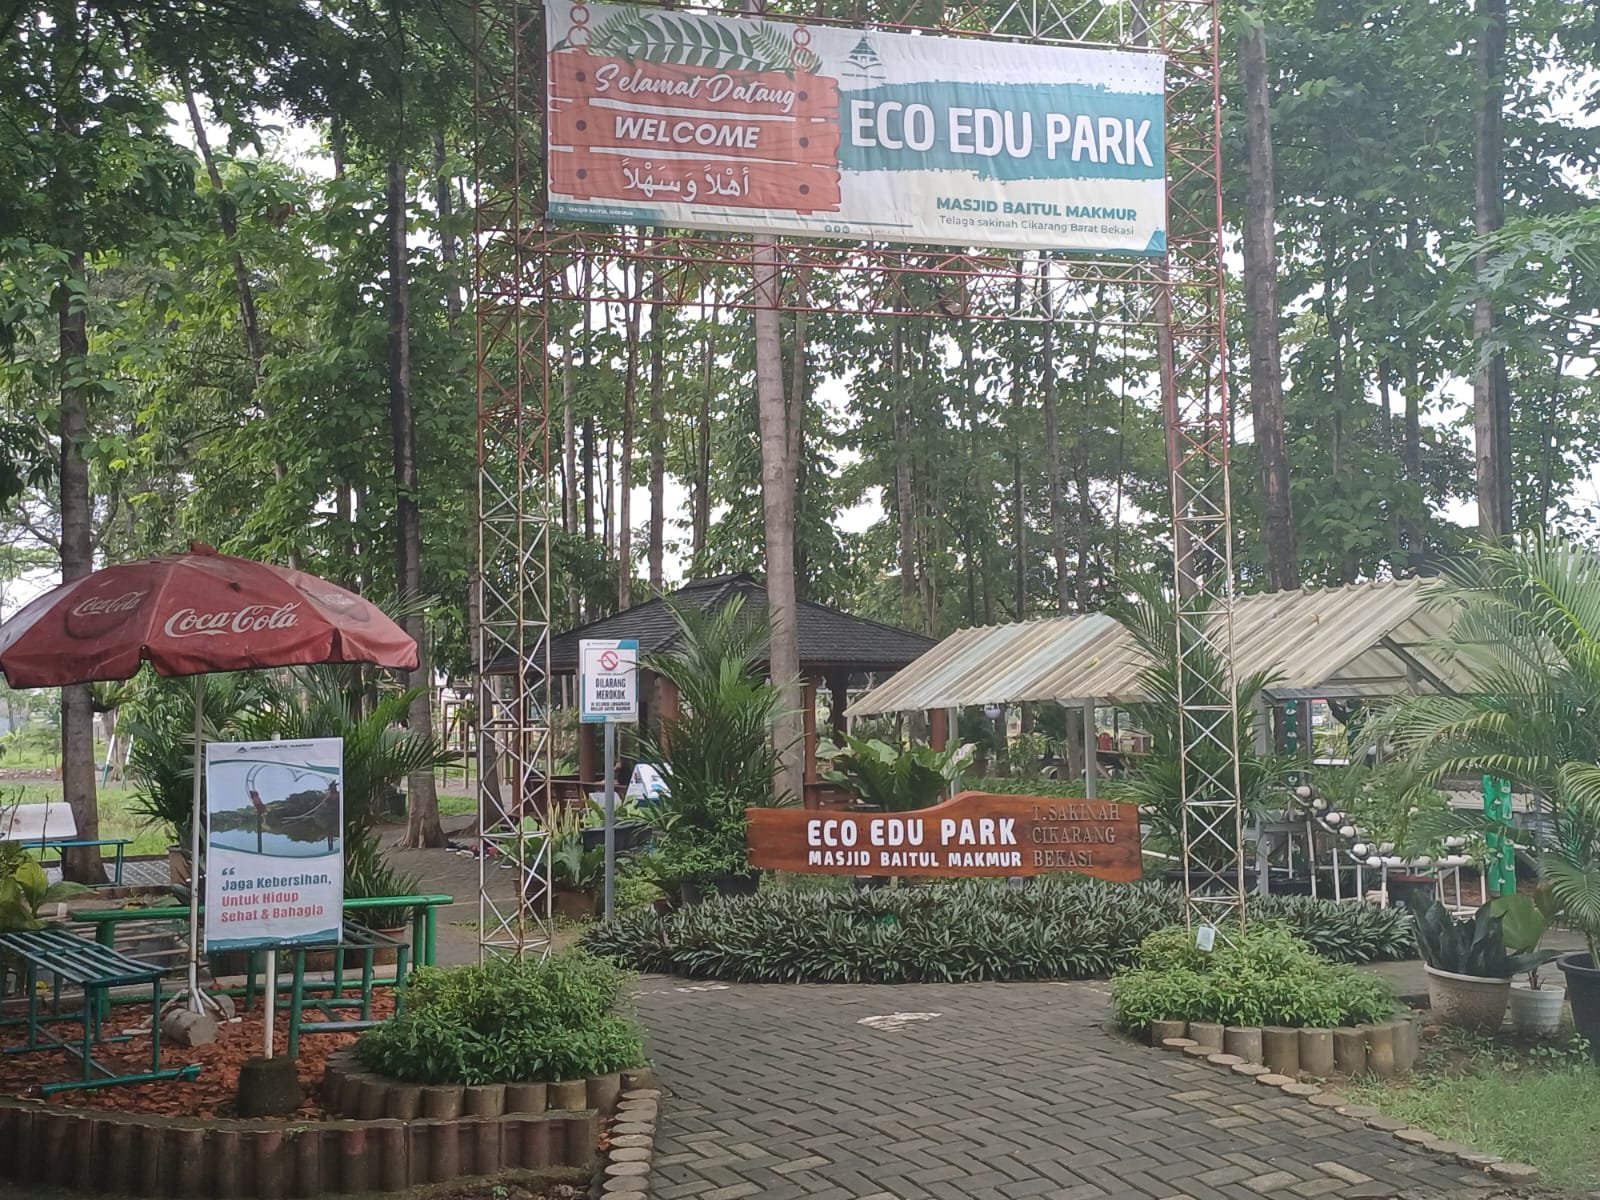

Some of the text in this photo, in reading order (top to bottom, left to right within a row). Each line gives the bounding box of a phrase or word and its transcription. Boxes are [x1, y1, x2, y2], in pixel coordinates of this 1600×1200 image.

[595, 63, 796, 113] Selamat Datang
[615, 116, 760, 149] WELCOME
[850, 99, 1154, 167] ECO EDU PARK
[936, 197, 1137, 222] MASJID BAITUL MAKMUR
[939, 214, 1134, 236] Telaga sakinah Cikarang Barat Bekasi
[164, 601, 302, 638] Coca-Cola
[595, 678, 626, 689] DILARANG
[596, 690, 626, 700] MEROKOK
[807, 818, 1017, 847] ECO EDU PARK
[1032, 826, 1117, 844] CIKARANG
[808, 850, 1022, 868] MASJID BAITUL MAKMUR
[1033, 849, 1094, 867] BEKASI
[221, 873, 332, 891] Jaga Kebersihan,
[221, 891, 299, 907] Untuk Hidup
[221, 904, 324, 923] Sehat & Bahagia
